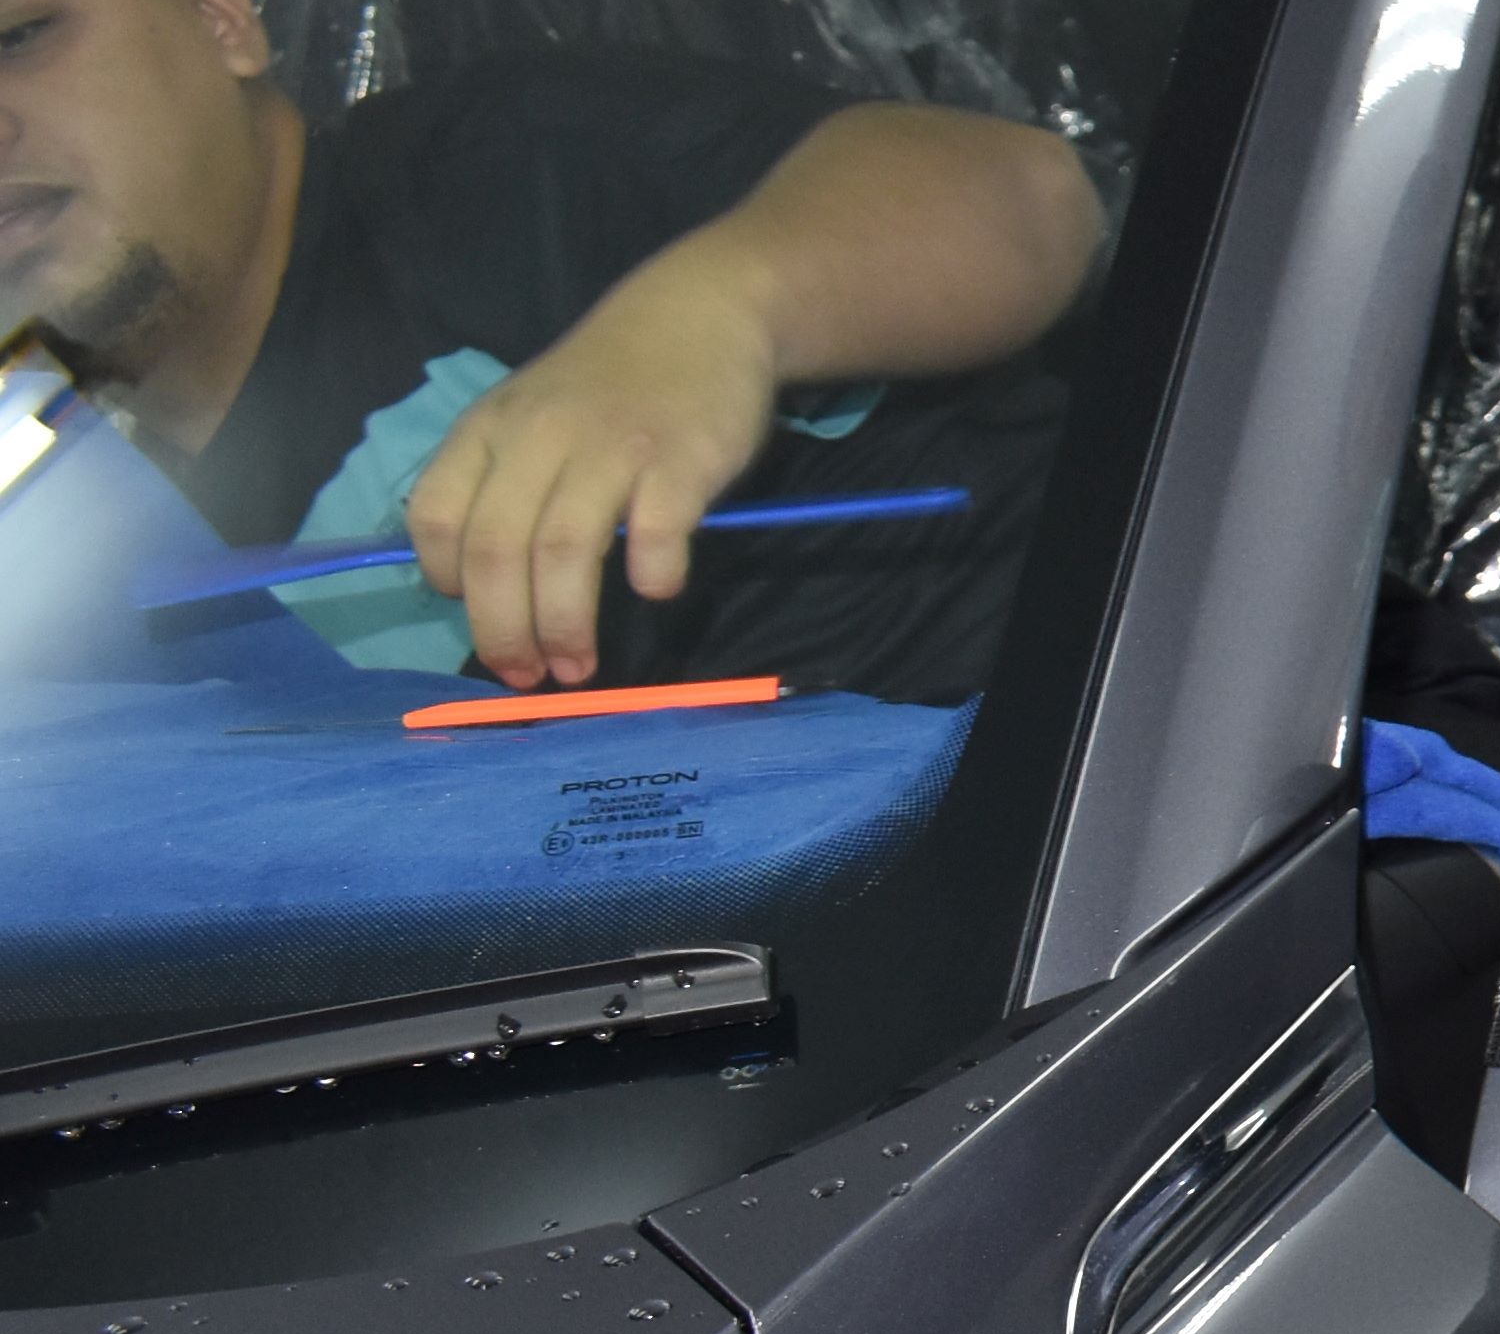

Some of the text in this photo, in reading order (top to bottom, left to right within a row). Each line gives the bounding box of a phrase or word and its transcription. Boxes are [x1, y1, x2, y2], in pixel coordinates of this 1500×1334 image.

[561, 770, 698, 795] PROTON
[568, 808, 683, 826] MADE IN MALAYSIA
